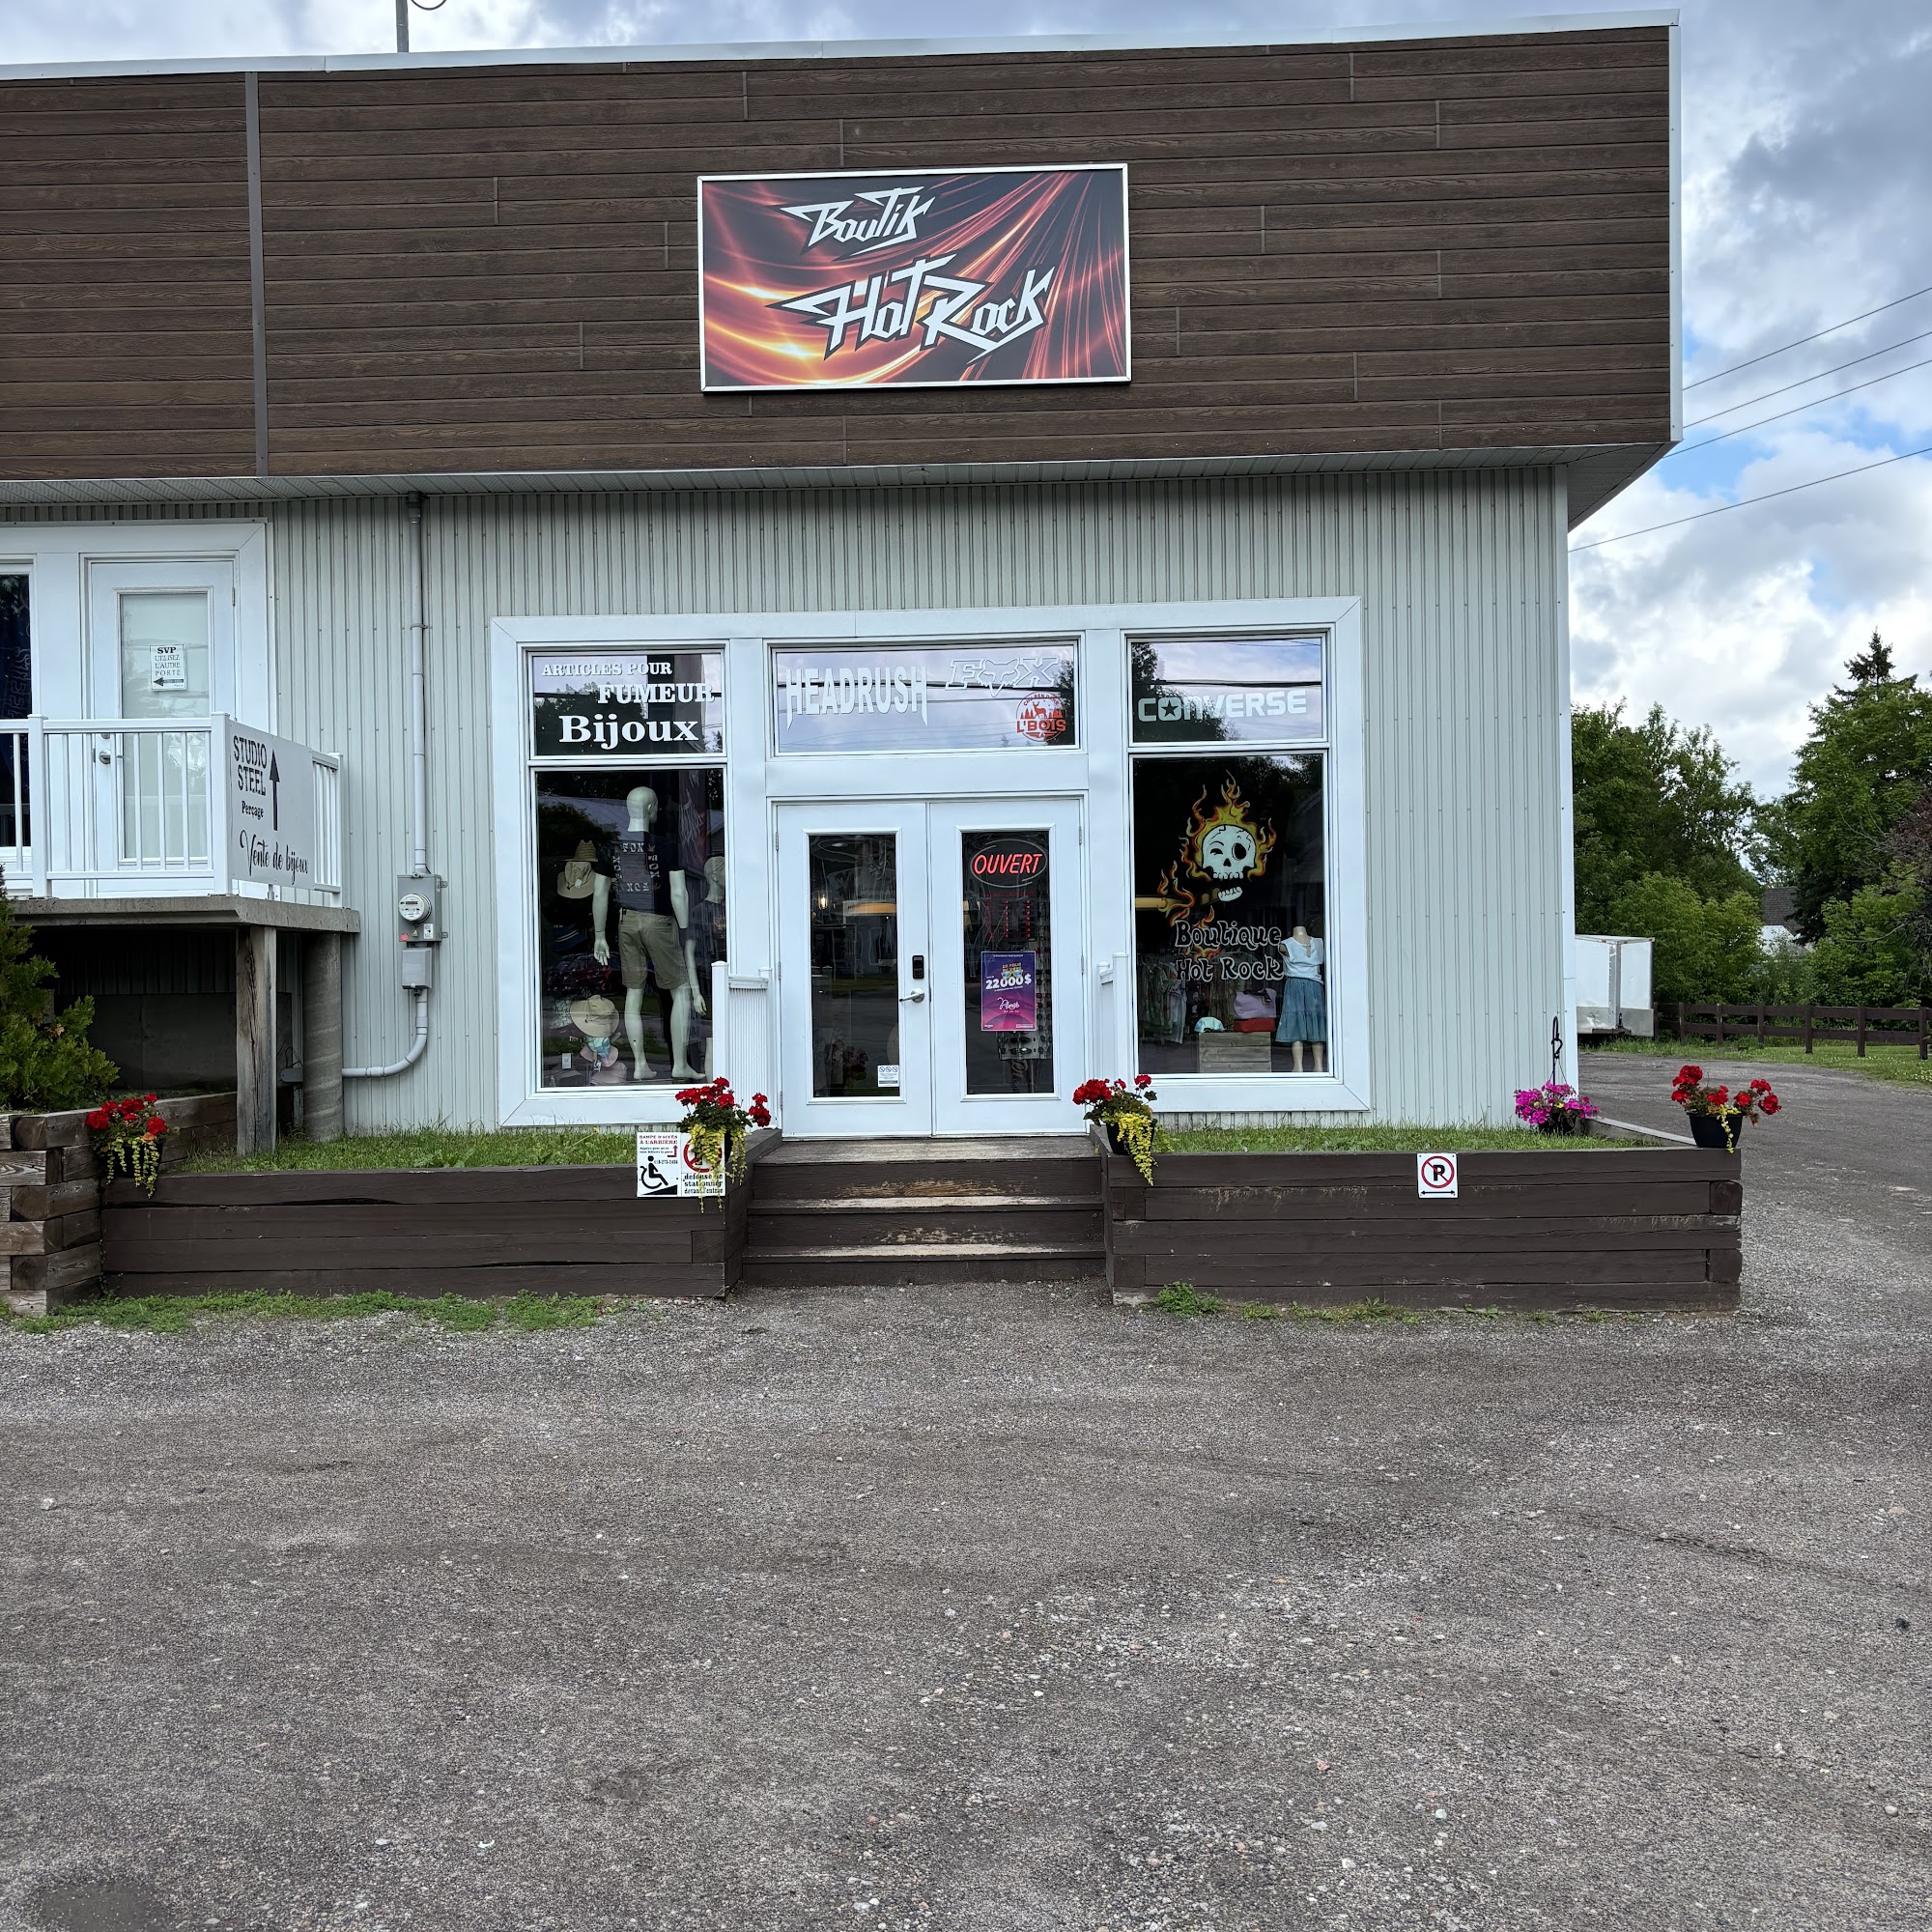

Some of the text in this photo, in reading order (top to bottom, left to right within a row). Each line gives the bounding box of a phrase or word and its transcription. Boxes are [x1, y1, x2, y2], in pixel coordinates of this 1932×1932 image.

[541, 662, 673, 676] ARTICLES POUR
[597, 682, 715, 704] FUMEUR
[784, 665, 928, 731] HEADRUSH
[1137, 690, 1307, 723] CONVERSE
[558, 713, 699, 750] Bijoux
[1016, 720, 1066, 733] L'BOIS
[233, 735, 268, 769] STUDIO
[238, 764, 267, 796] STEEL
[242, 800, 265, 820] Perçage
[240, 830, 309, 885] Vente de bijoux
[622, 842, 644, 853] FOX
[974, 854, 1043, 874] OUVERT
[1175, 920, 1282, 951] Boutique
[1176, 953, 1285, 982] Hot Rock
